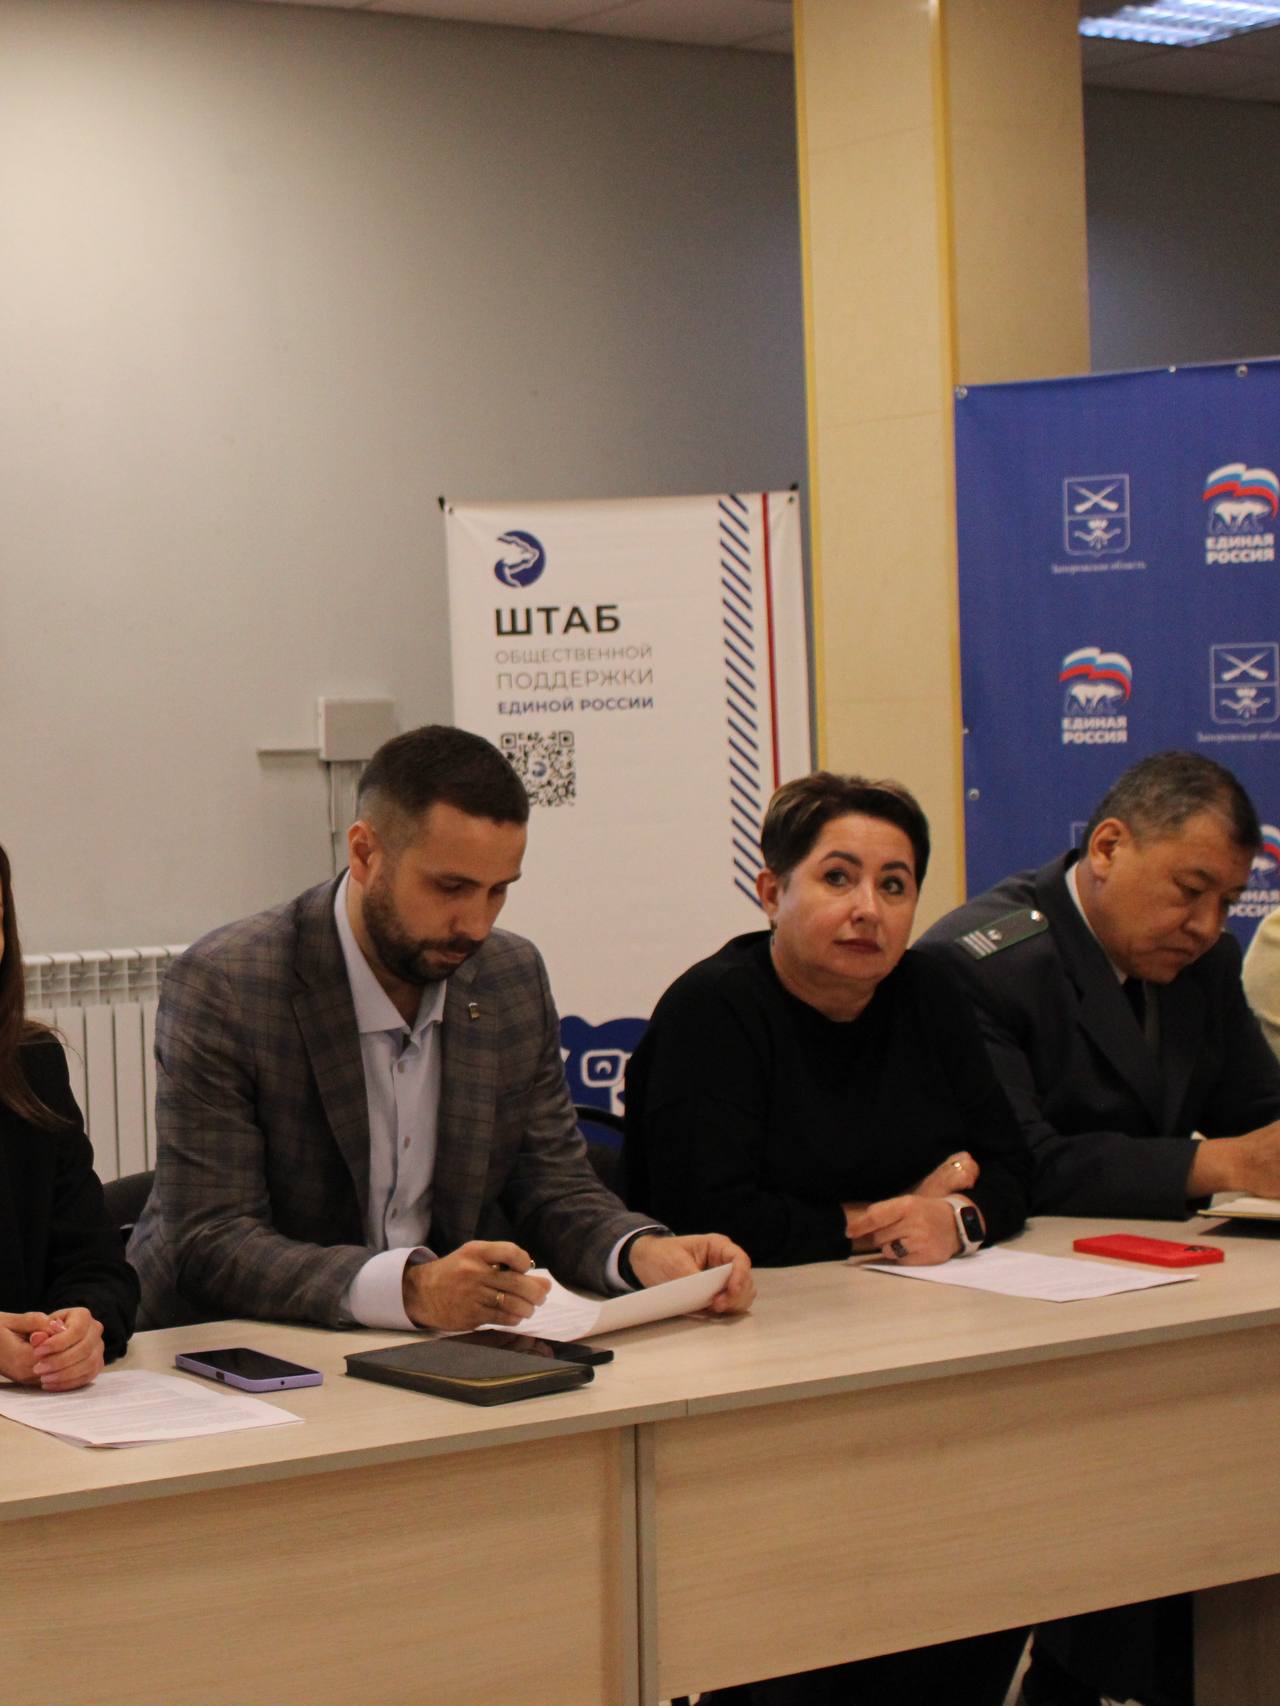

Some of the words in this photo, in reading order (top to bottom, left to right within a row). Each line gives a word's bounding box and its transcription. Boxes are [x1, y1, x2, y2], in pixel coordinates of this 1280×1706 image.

[1206, 533, 1275, 550] ЕДИНАЯ
[1206, 548, 1275, 565] РОССИЯ
[495, 604, 621, 636] ШТАБ
[495, 643, 653, 665] ОБЩЕСТВЕННОЙ
[497, 669, 654, 691] ПОДДЕРЖКИ
[498, 698, 574, 716] ЕДИНОЙ
[580, 697, 654, 712] РОССИИ
[1061, 715, 1128, 730] ЕДИНАЯ
[1062, 730, 1128, 745] РОССИЯ
